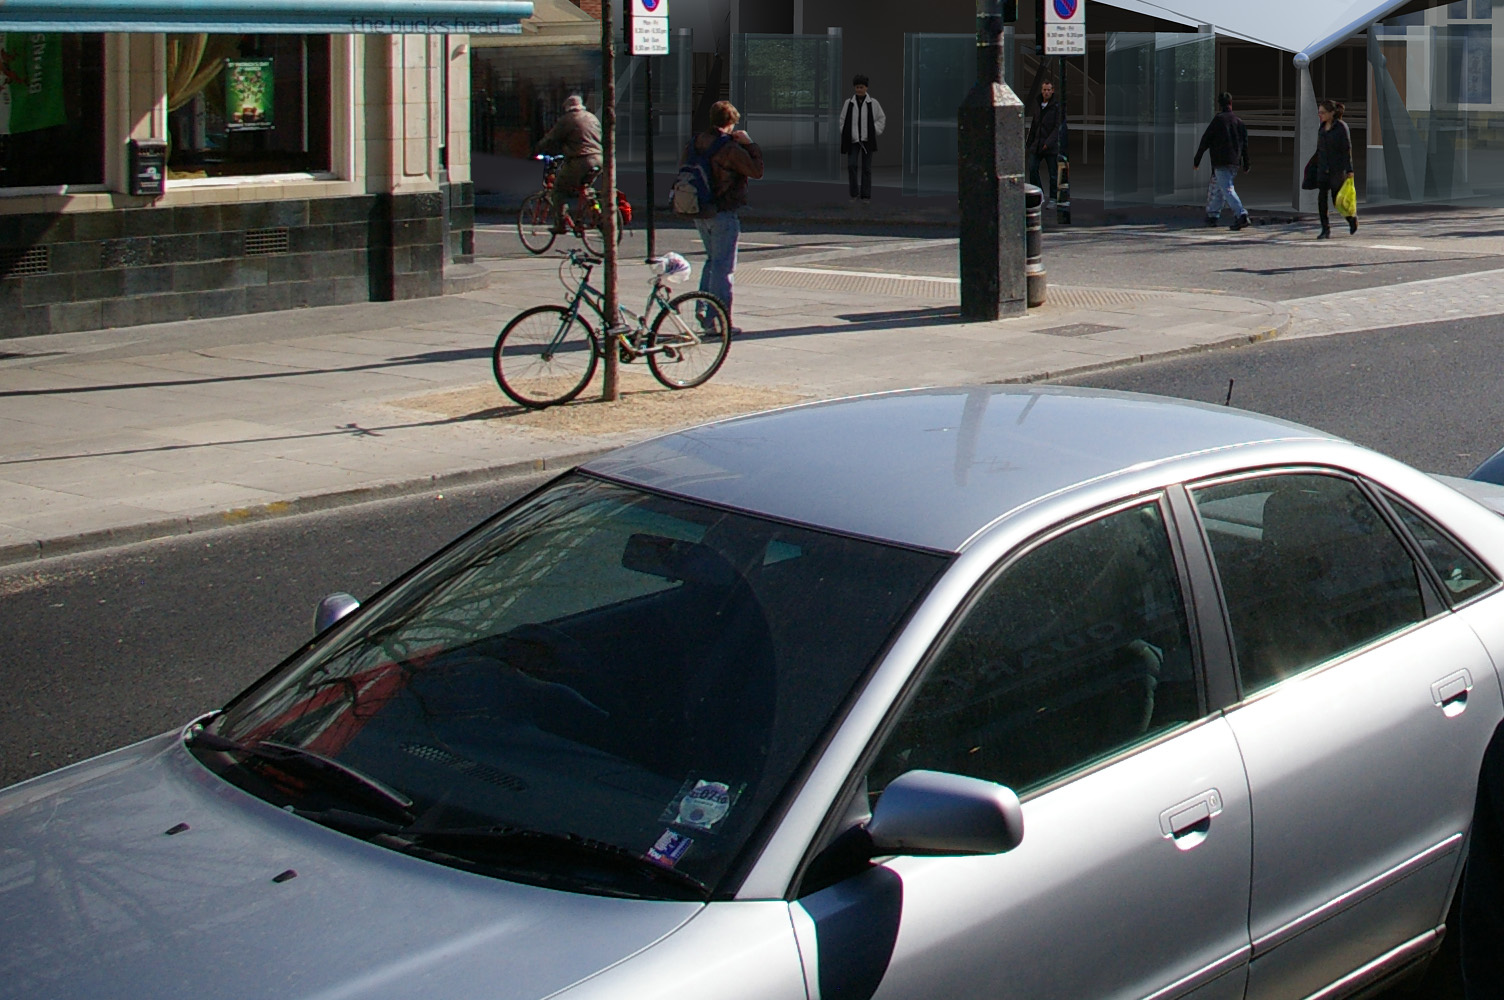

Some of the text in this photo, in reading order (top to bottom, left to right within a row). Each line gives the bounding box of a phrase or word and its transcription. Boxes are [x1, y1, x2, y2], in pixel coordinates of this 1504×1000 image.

[351, 16, 501, 33] the bucks head
